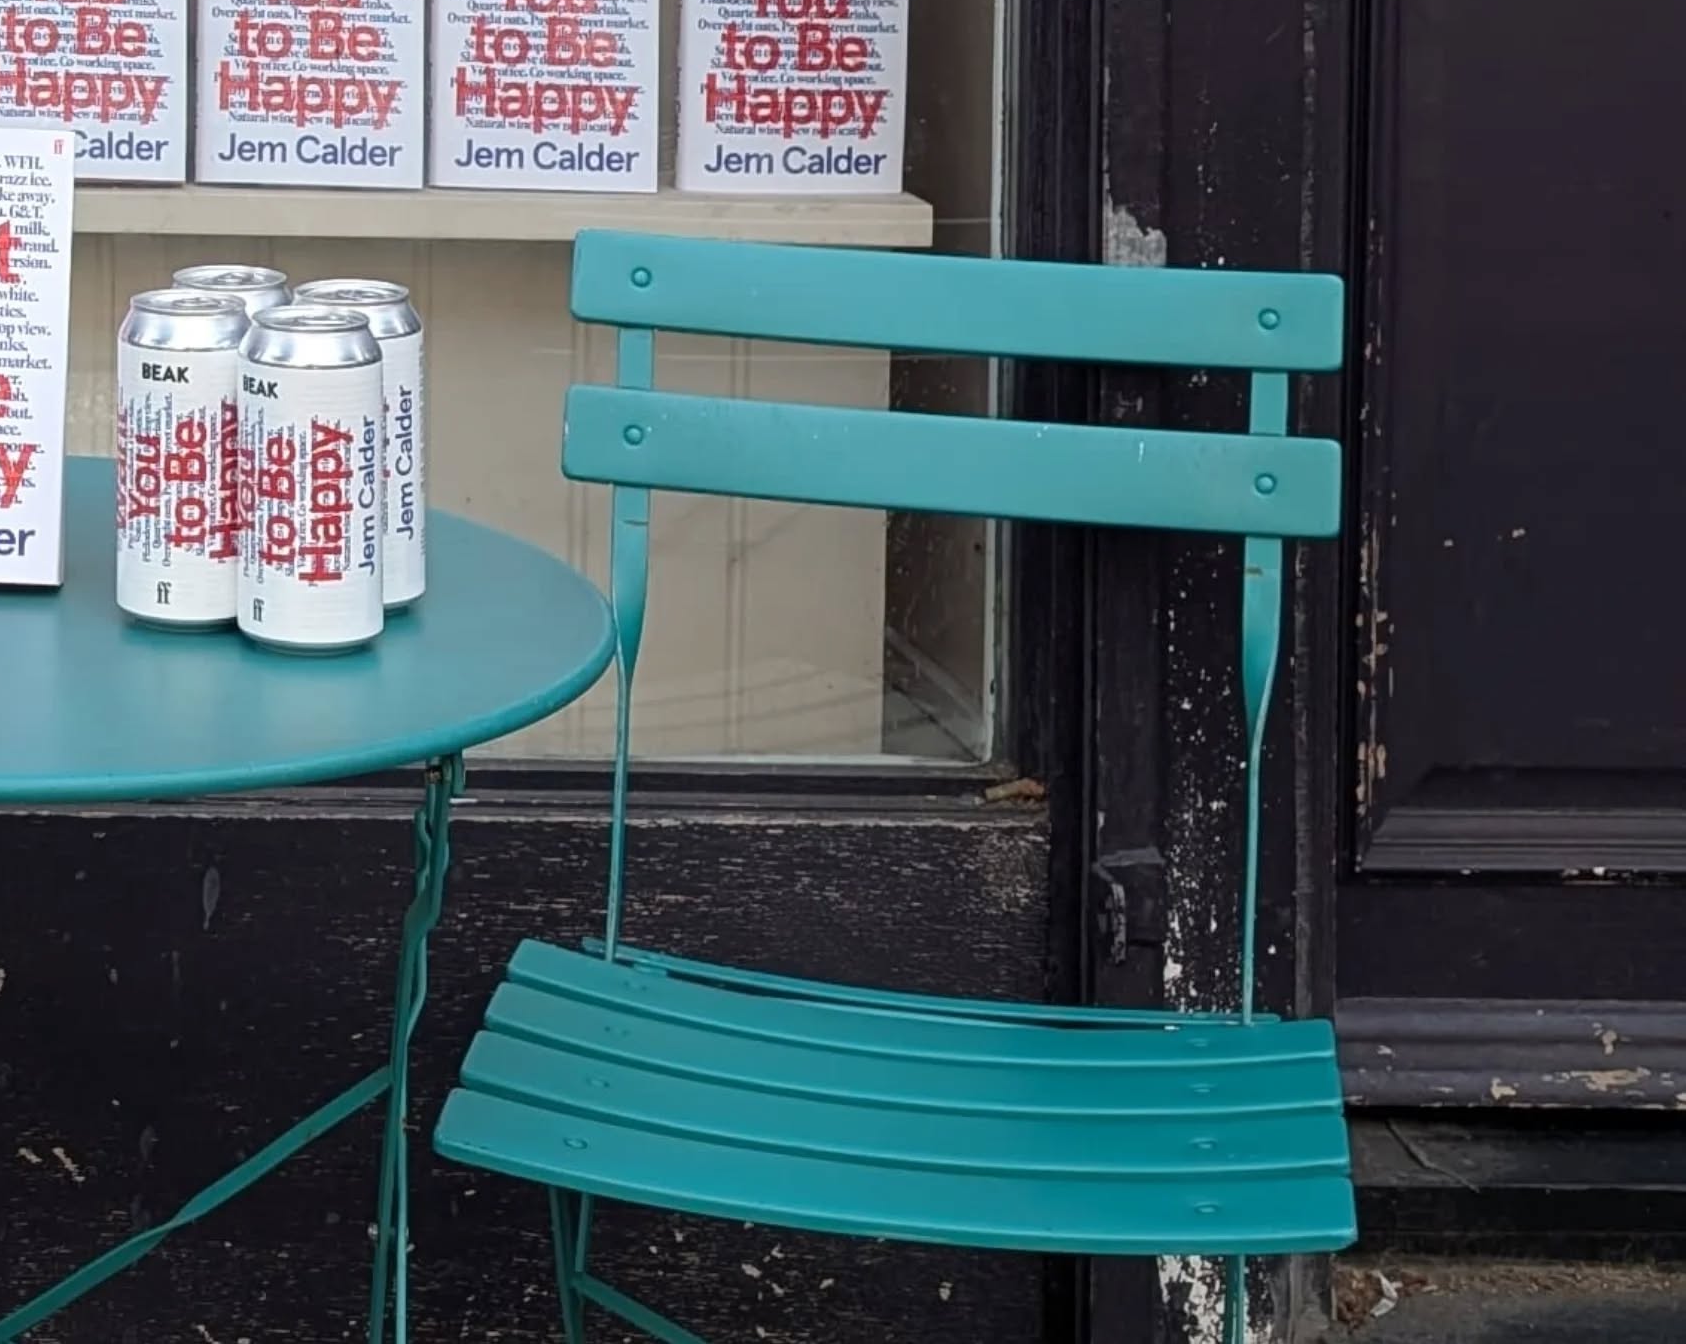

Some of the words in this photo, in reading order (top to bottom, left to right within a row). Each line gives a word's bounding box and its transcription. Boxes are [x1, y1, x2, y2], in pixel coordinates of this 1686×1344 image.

[0, 6, 59, 56] to
[72, 7, 148, 58] Be
[471, 15, 531, 65] to
[544, 16, 619, 67] Be
[720, 22, 781, 72] to
[794, 23, 869, 73] Be
[454, 66, 638, 135] Happy
[705, 73, 890, 140] Happy
[454, 139, 524, 170] Jem
[532, 140, 640, 173] Calder
[704, 145, 774, 176] Jem
[782, 145, 887, 178] Calder
[141, 361, 191, 384] BEAK
[242, 374, 279, 400] BEAK
[163, 417, 207, 482] Be
[394, 385, 413, 478] Calder
[129, 433, 161, 520] You
[258, 434, 297, 500] Be
[357, 416, 377, 507] Calder
[165, 496, 208, 549] to
[298, 417, 354, 581] Happy
[395, 489, 414, 541] Jem
[259, 514, 297, 565] to
[357, 514, 376, 576] Jem
[155, 582, 172, 606] ff
